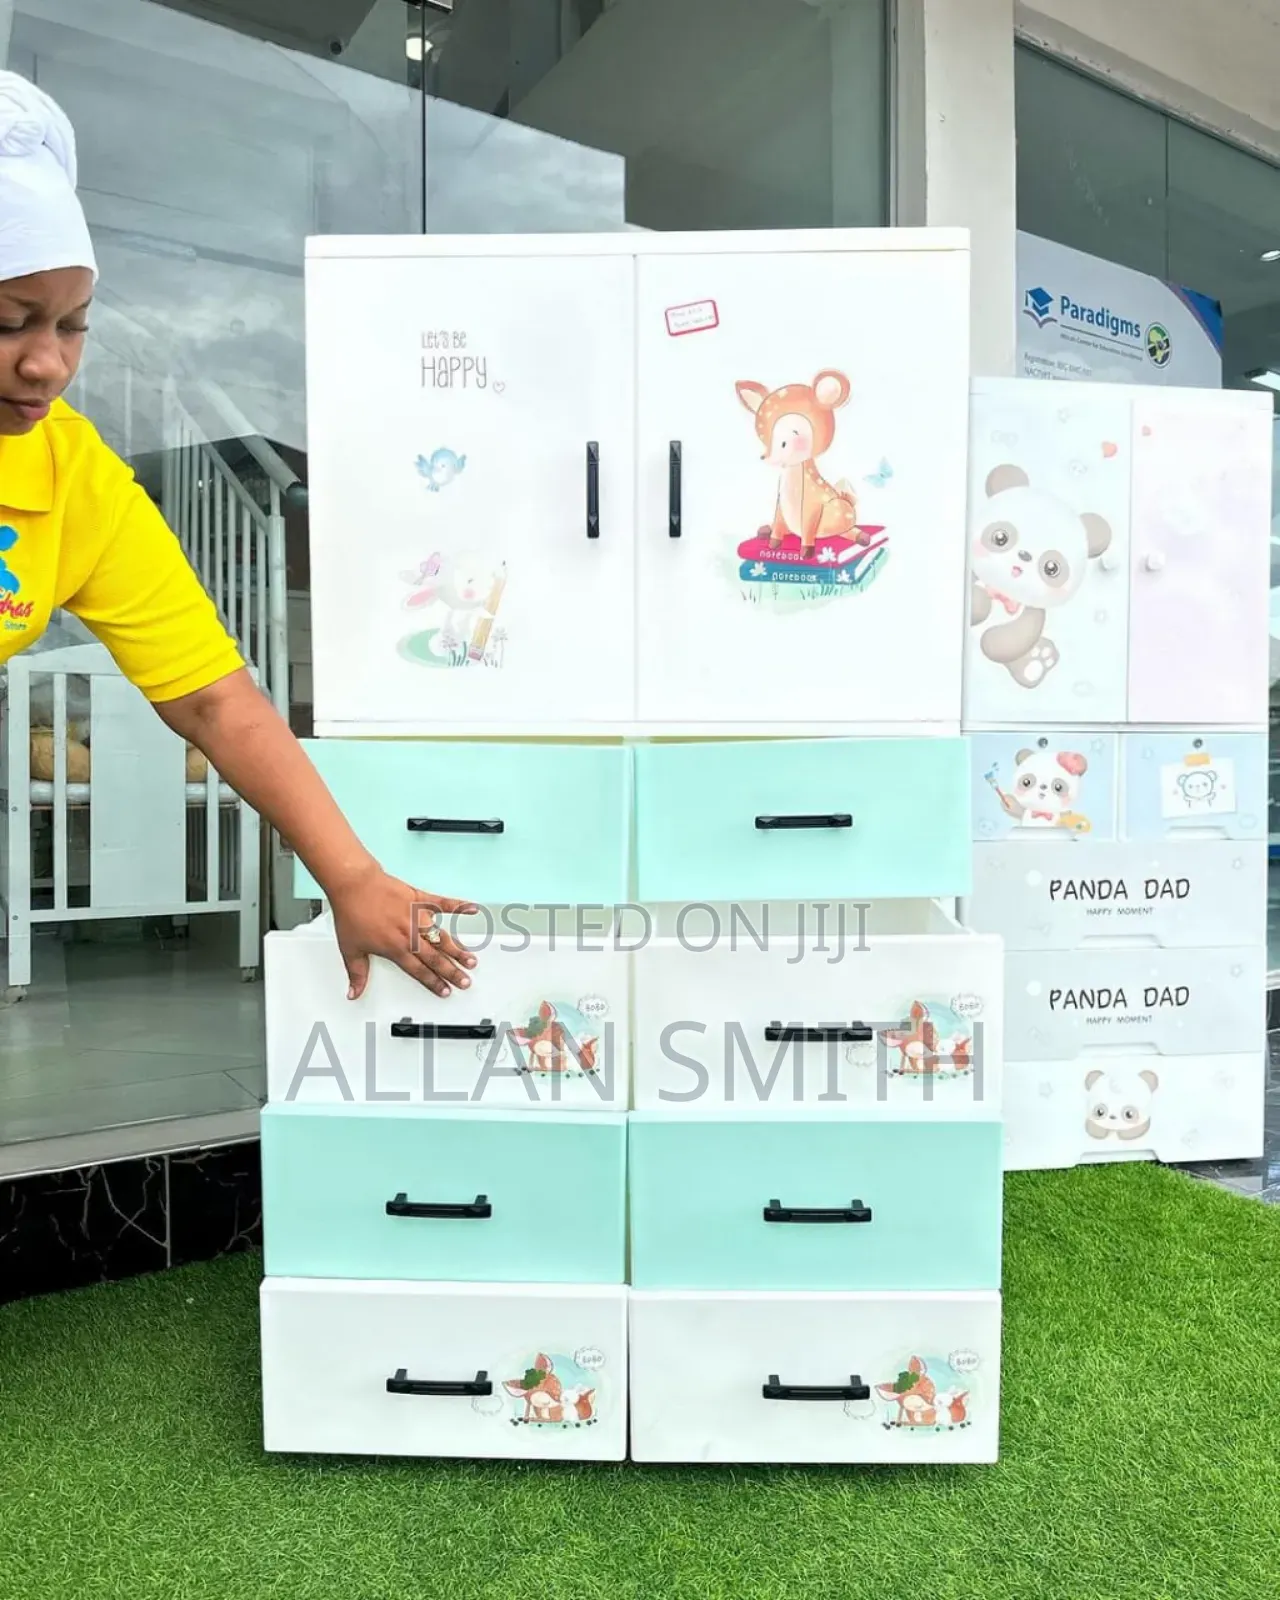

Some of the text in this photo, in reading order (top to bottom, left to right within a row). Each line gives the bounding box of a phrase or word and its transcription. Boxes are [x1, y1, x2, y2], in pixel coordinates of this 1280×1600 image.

[1060, 295, 1141, 338] Paradigms
[1049, 878, 1190, 900] PANDA DAD
[1086, 907, 1153, 916] HAPPY MOMENT
[1049, 986, 1190, 1010] PANDA DAD
[1086, 1015, 1153, 1025] HAPPY MOMENT
